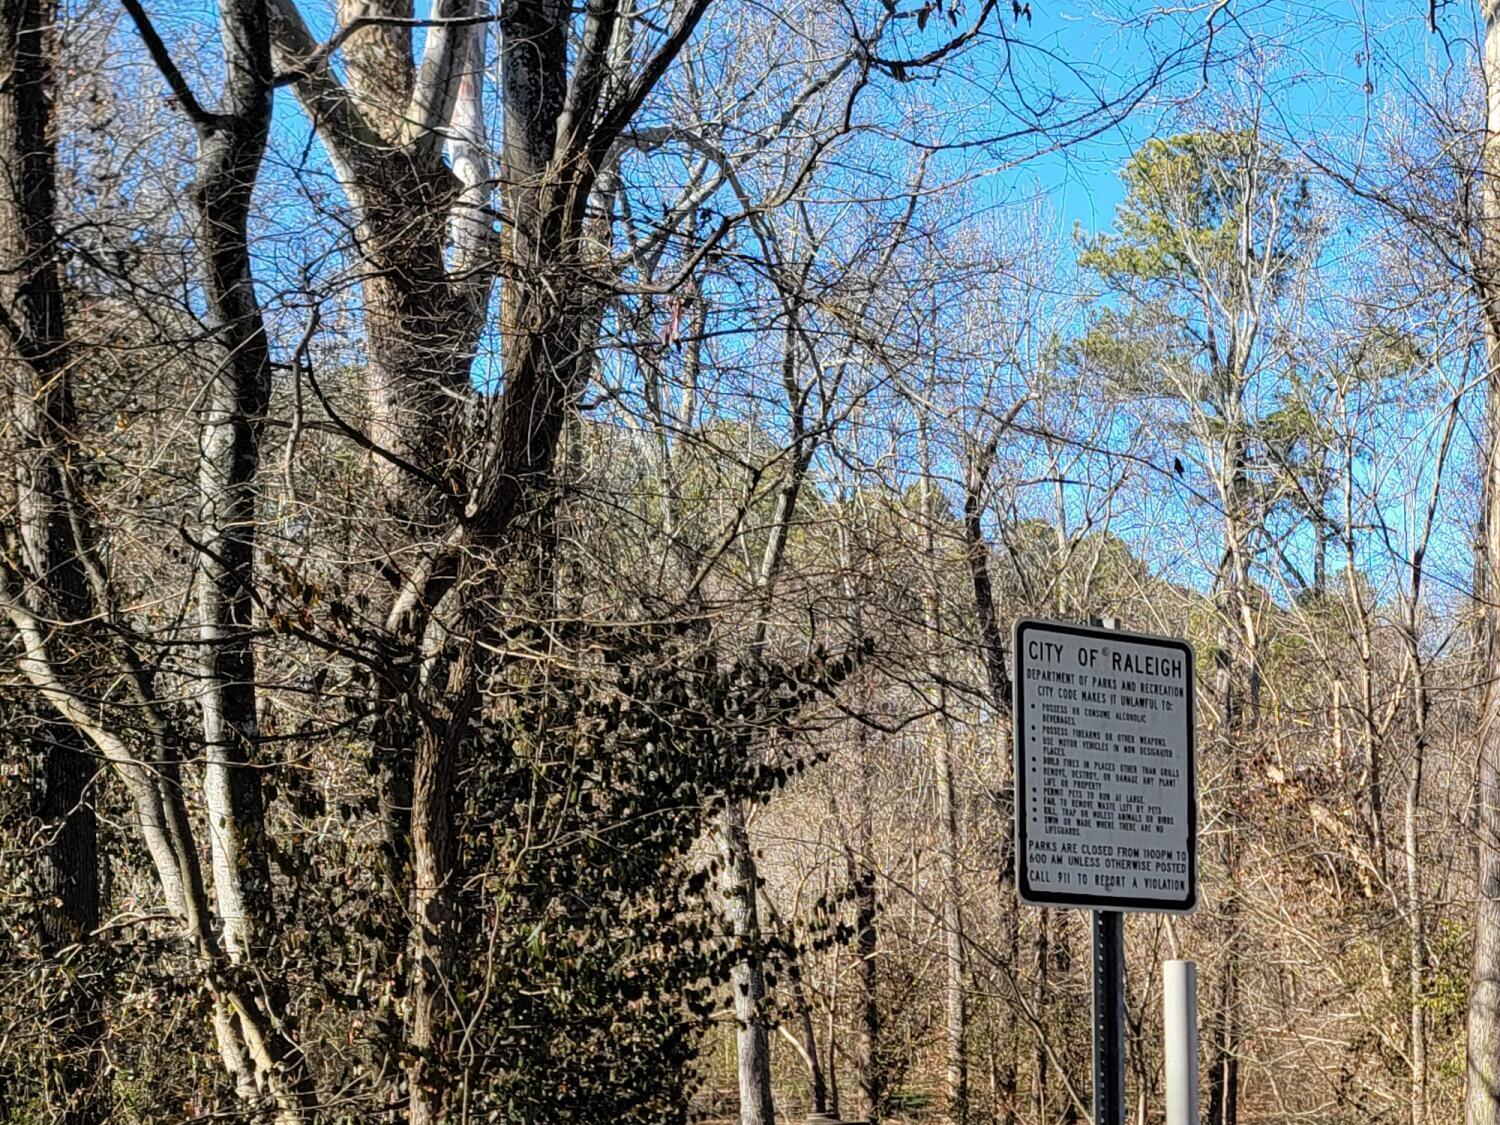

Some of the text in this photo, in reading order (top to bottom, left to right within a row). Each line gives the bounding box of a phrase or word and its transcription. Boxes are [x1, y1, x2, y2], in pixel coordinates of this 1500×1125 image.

[1029, 641, 1181, 679] CITY OF RALEIGH
[1027, 668, 1184, 697] DEPARTMENT OF PARKS AND RECREATION
[1038, 685, 1173, 711] CITY CODE MAKES IT UNLAWFUL TO:
[1042, 703, 1146, 723] POSSESS OR CONSUME ALCOHOLIC
[1042, 725, 1068, 736] POSSESS
[1073, 729, 1100, 740] FIREARMS
[1105, 732, 1112, 741] OR
[1118, 734, 1135, 744] OTHER
[1042, 736, 1173, 758] USE MOTOR VEHICLES IN NON DESIGNATED
[1043, 756, 1059, 766] BUILD
[1063, 758, 1079, 768] FIRES
[1084, 760, 1089, 769] IN
[1094, 761, 1115, 771] PLACES
[1120, 764, 1137, 773] OTHER
[1142, 766, 1156, 775] THAN
[1043, 778, 1055, 787] LIFE
[1061, 779, 1068, 787] OR
[1103, 773, 1110, 781] OR
[1116, 774, 1138, 784] DAMAGE
[1143, 777, 1154, 785] ANY
[1159, 778, 1176, 787] PLANT
[1043, 787, 1063, 796] PERMIT
[1068, 789, 1082, 799] PETS
[1087, 791, 1094, 799] TO
[1099, 792, 1110, 801] RUN
[1115, 793, 1121, 801] AT
[1043, 796, 1056, 806] FAIL
[1060, 798, 1067, 807] TO
[1072, 799, 1093, 809] REMOVE
[1098, 801, 1115, 811] WASTE
[1120, 803, 1132, 812] LEFT
[1136, 805, 1144, 813] BY
[1044, 816, 1164, 833] SWIM OR WADE WHERE THERE ARE NO
[1062, 808, 1076, 816] TRAP
[1081, 809, 1088, 817] OR
[1093, 811, 1114, 819] MOLEST
[1118, 813, 1142, 822] ANIMALS
[1146, 815, 1153, 823] OR
[1158, 816, 1174, 825] BIRDS
[1029, 840, 1057, 852] PARKS
[1061, 842, 1078, 854] ARE
[1081, 844, 1113, 856] CLOSED
[1117, 847, 1139, 858] FROM
[1176, 850, 1186, 861] TO
[1051, 854, 1063, 865] AM
[1068, 856, 1100, 868] UNLESS
[1105, 858, 1151, 871] OTHERWISE
[1155, 862, 1186, 873] POSTED
[1030, 870, 1185, 891] CALL 911 TO REPORT A VIOLATION
